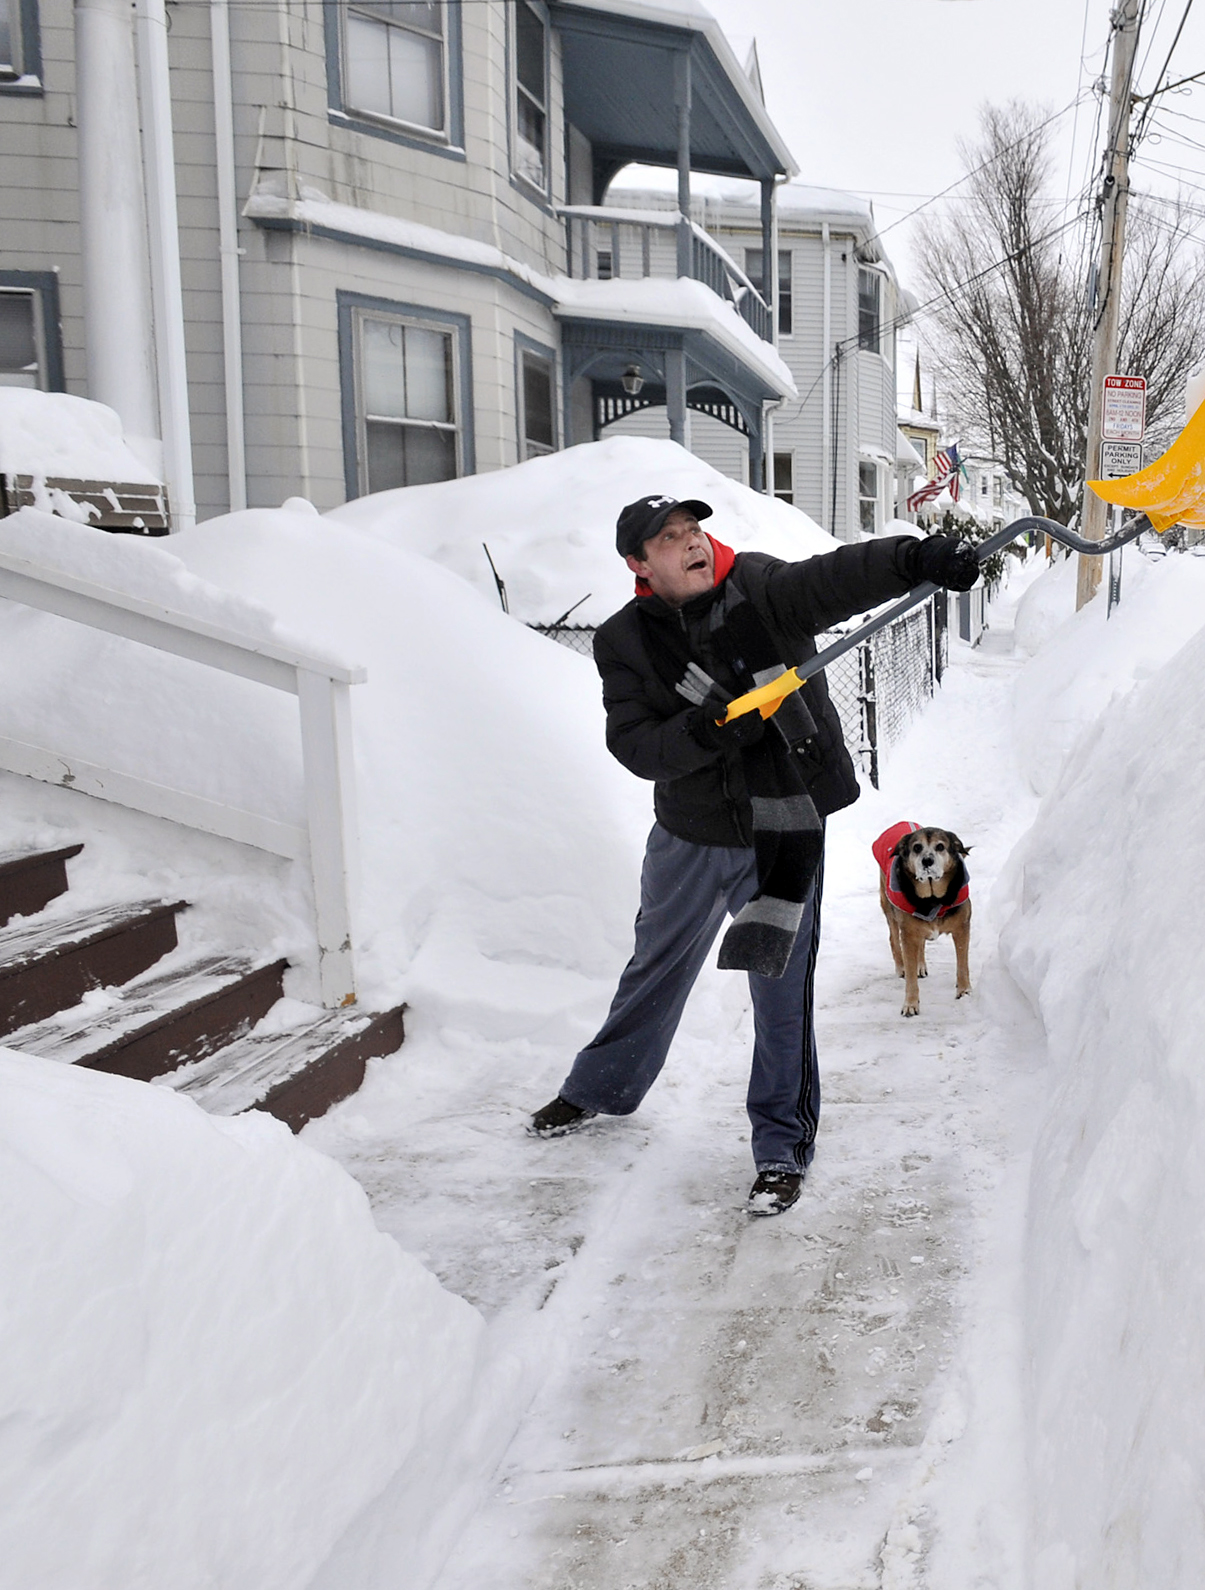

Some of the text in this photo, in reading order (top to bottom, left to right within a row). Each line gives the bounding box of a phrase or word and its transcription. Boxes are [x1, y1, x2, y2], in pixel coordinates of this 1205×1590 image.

[1107, 378, 1143, 388] TOW ZONE
[1117, 391, 1142, 399] PARKING
[1125, 410, 1141, 418] NOON
[1105, 451, 1138, 459] PARKING
